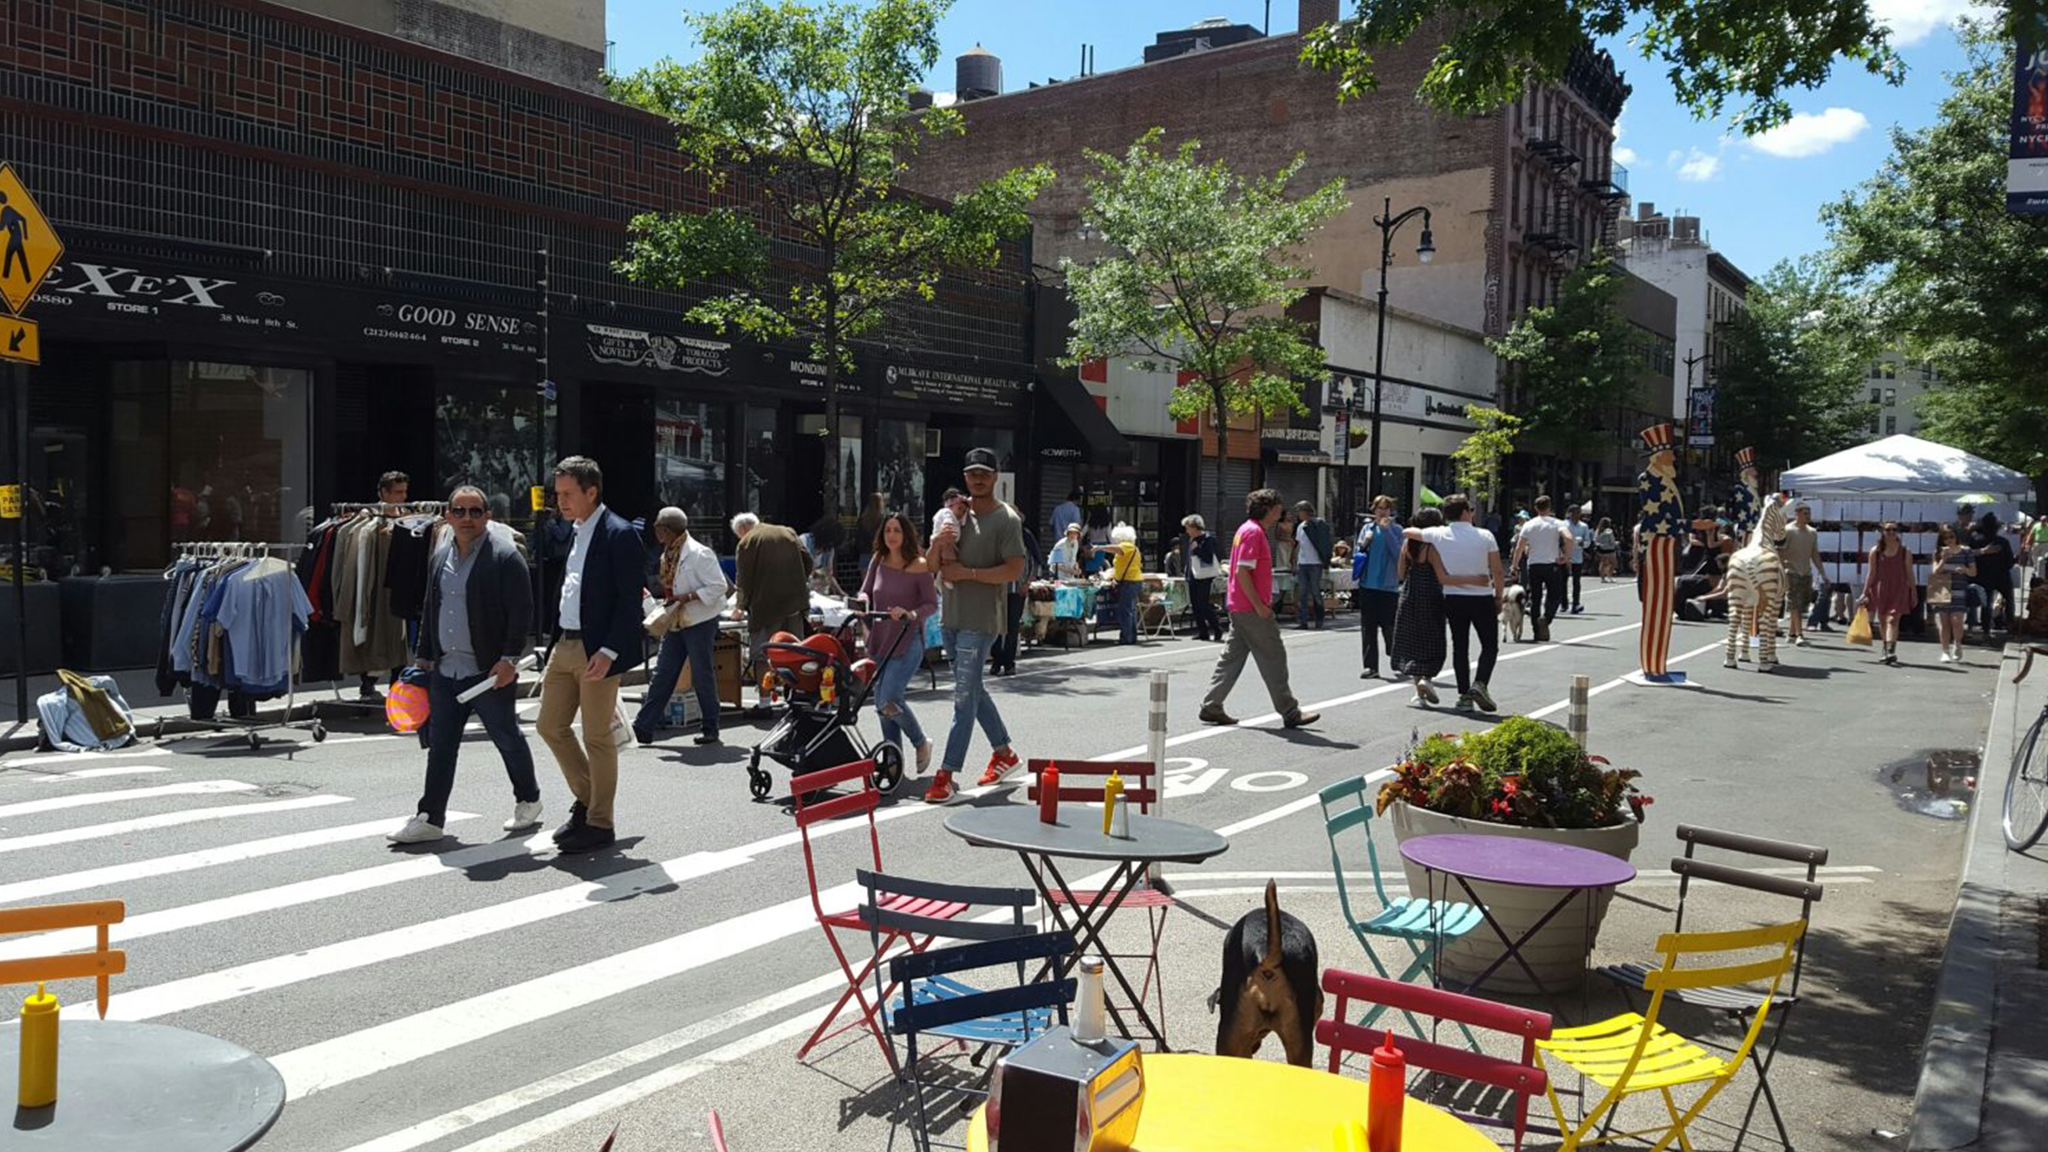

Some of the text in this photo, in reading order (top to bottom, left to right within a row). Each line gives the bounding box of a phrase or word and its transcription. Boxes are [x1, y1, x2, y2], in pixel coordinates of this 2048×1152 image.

[107, 302, 158, 315] STORE 1
[236, 314, 259, 325] West
[398, 304, 520, 335] GOOD SENSE
[441, 335, 480, 347] STORE 2
[602, 338, 626, 347] GIFTS
[599, 345, 639, 359] NOVELTY
[685, 348, 720, 359] TOBACCO
[682, 355, 723, 369] PRODUCTS
